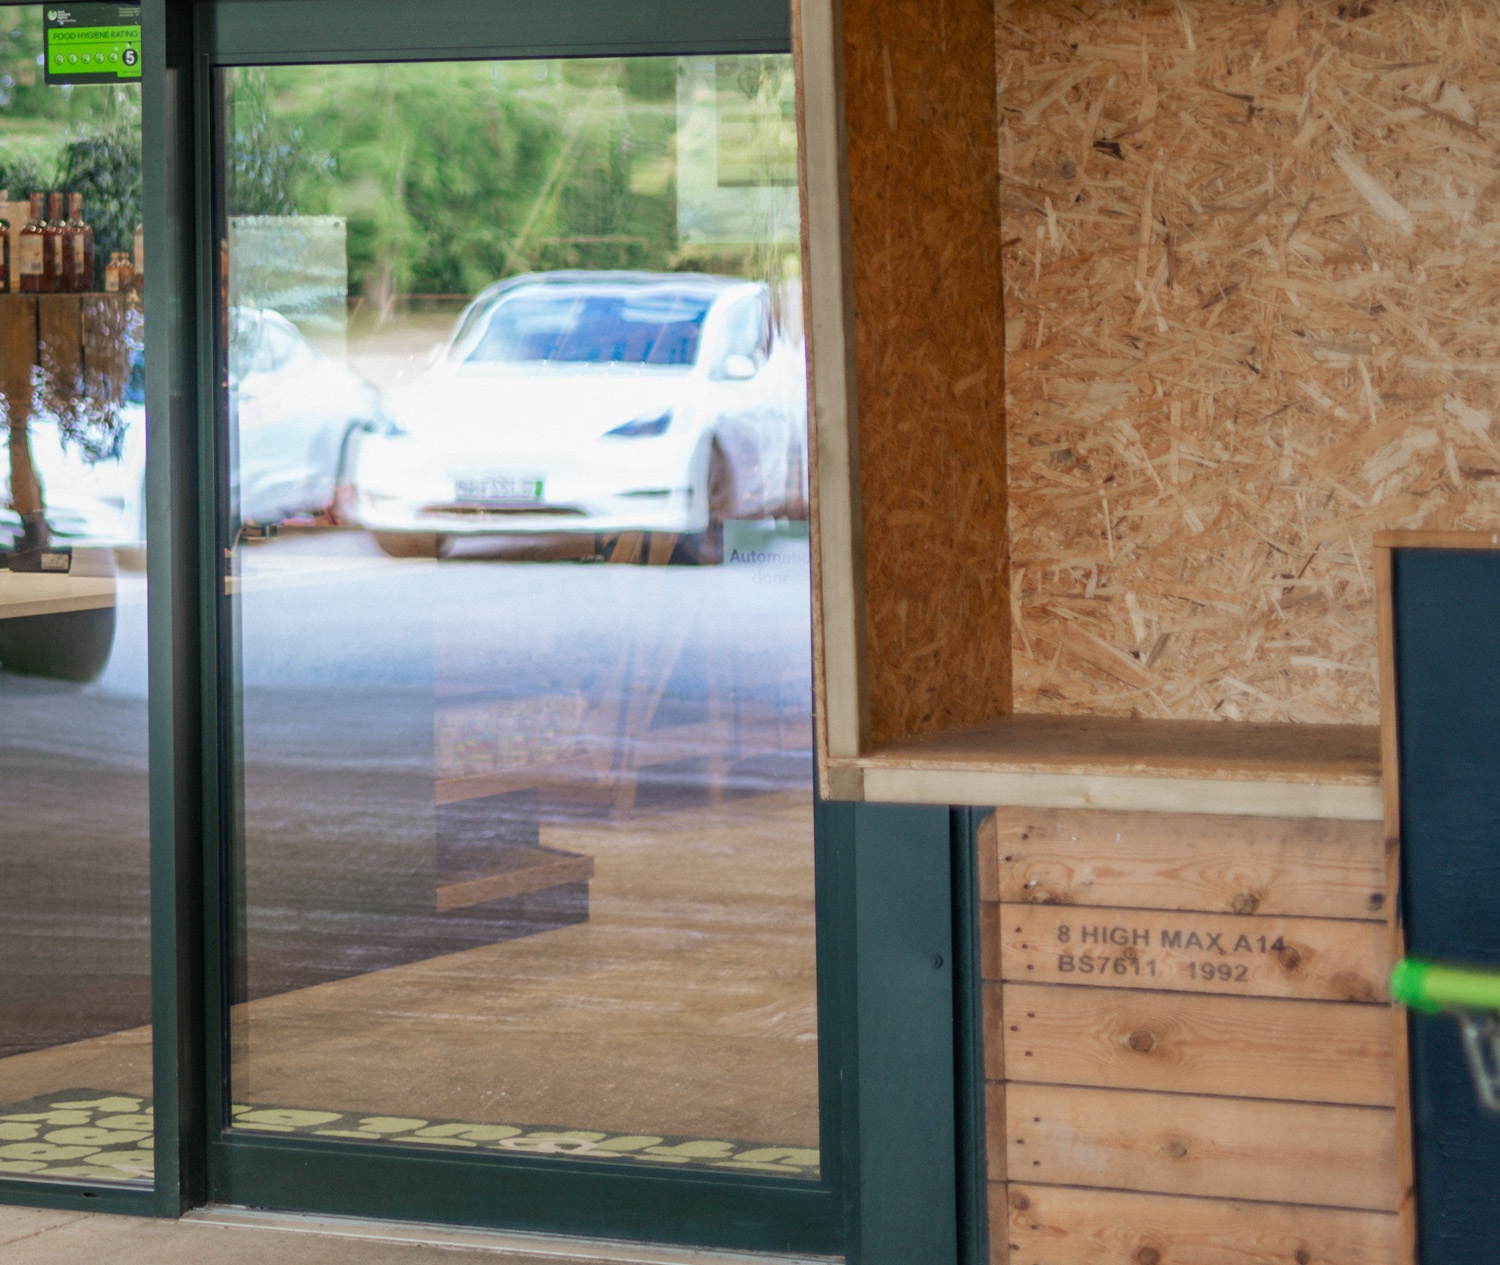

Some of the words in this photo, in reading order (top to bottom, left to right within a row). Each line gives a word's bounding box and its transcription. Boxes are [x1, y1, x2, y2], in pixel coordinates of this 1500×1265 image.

[53, 32, 76, 40] FOOD
[78, 31, 109, 39] HYGIENE
[111, 30, 139, 38] RATING
[125, 50, 135, 65] 5
[1057, 925, 1071, 944] 8
[1081, 926, 1150, 946] HIGH
[1161, 929, 1223, 952] MAX
[1233, 935, 1286, 953] A14
[1057, 954, 1156, 977] BS7611
[1188, 961, 1249, 982] 1992
